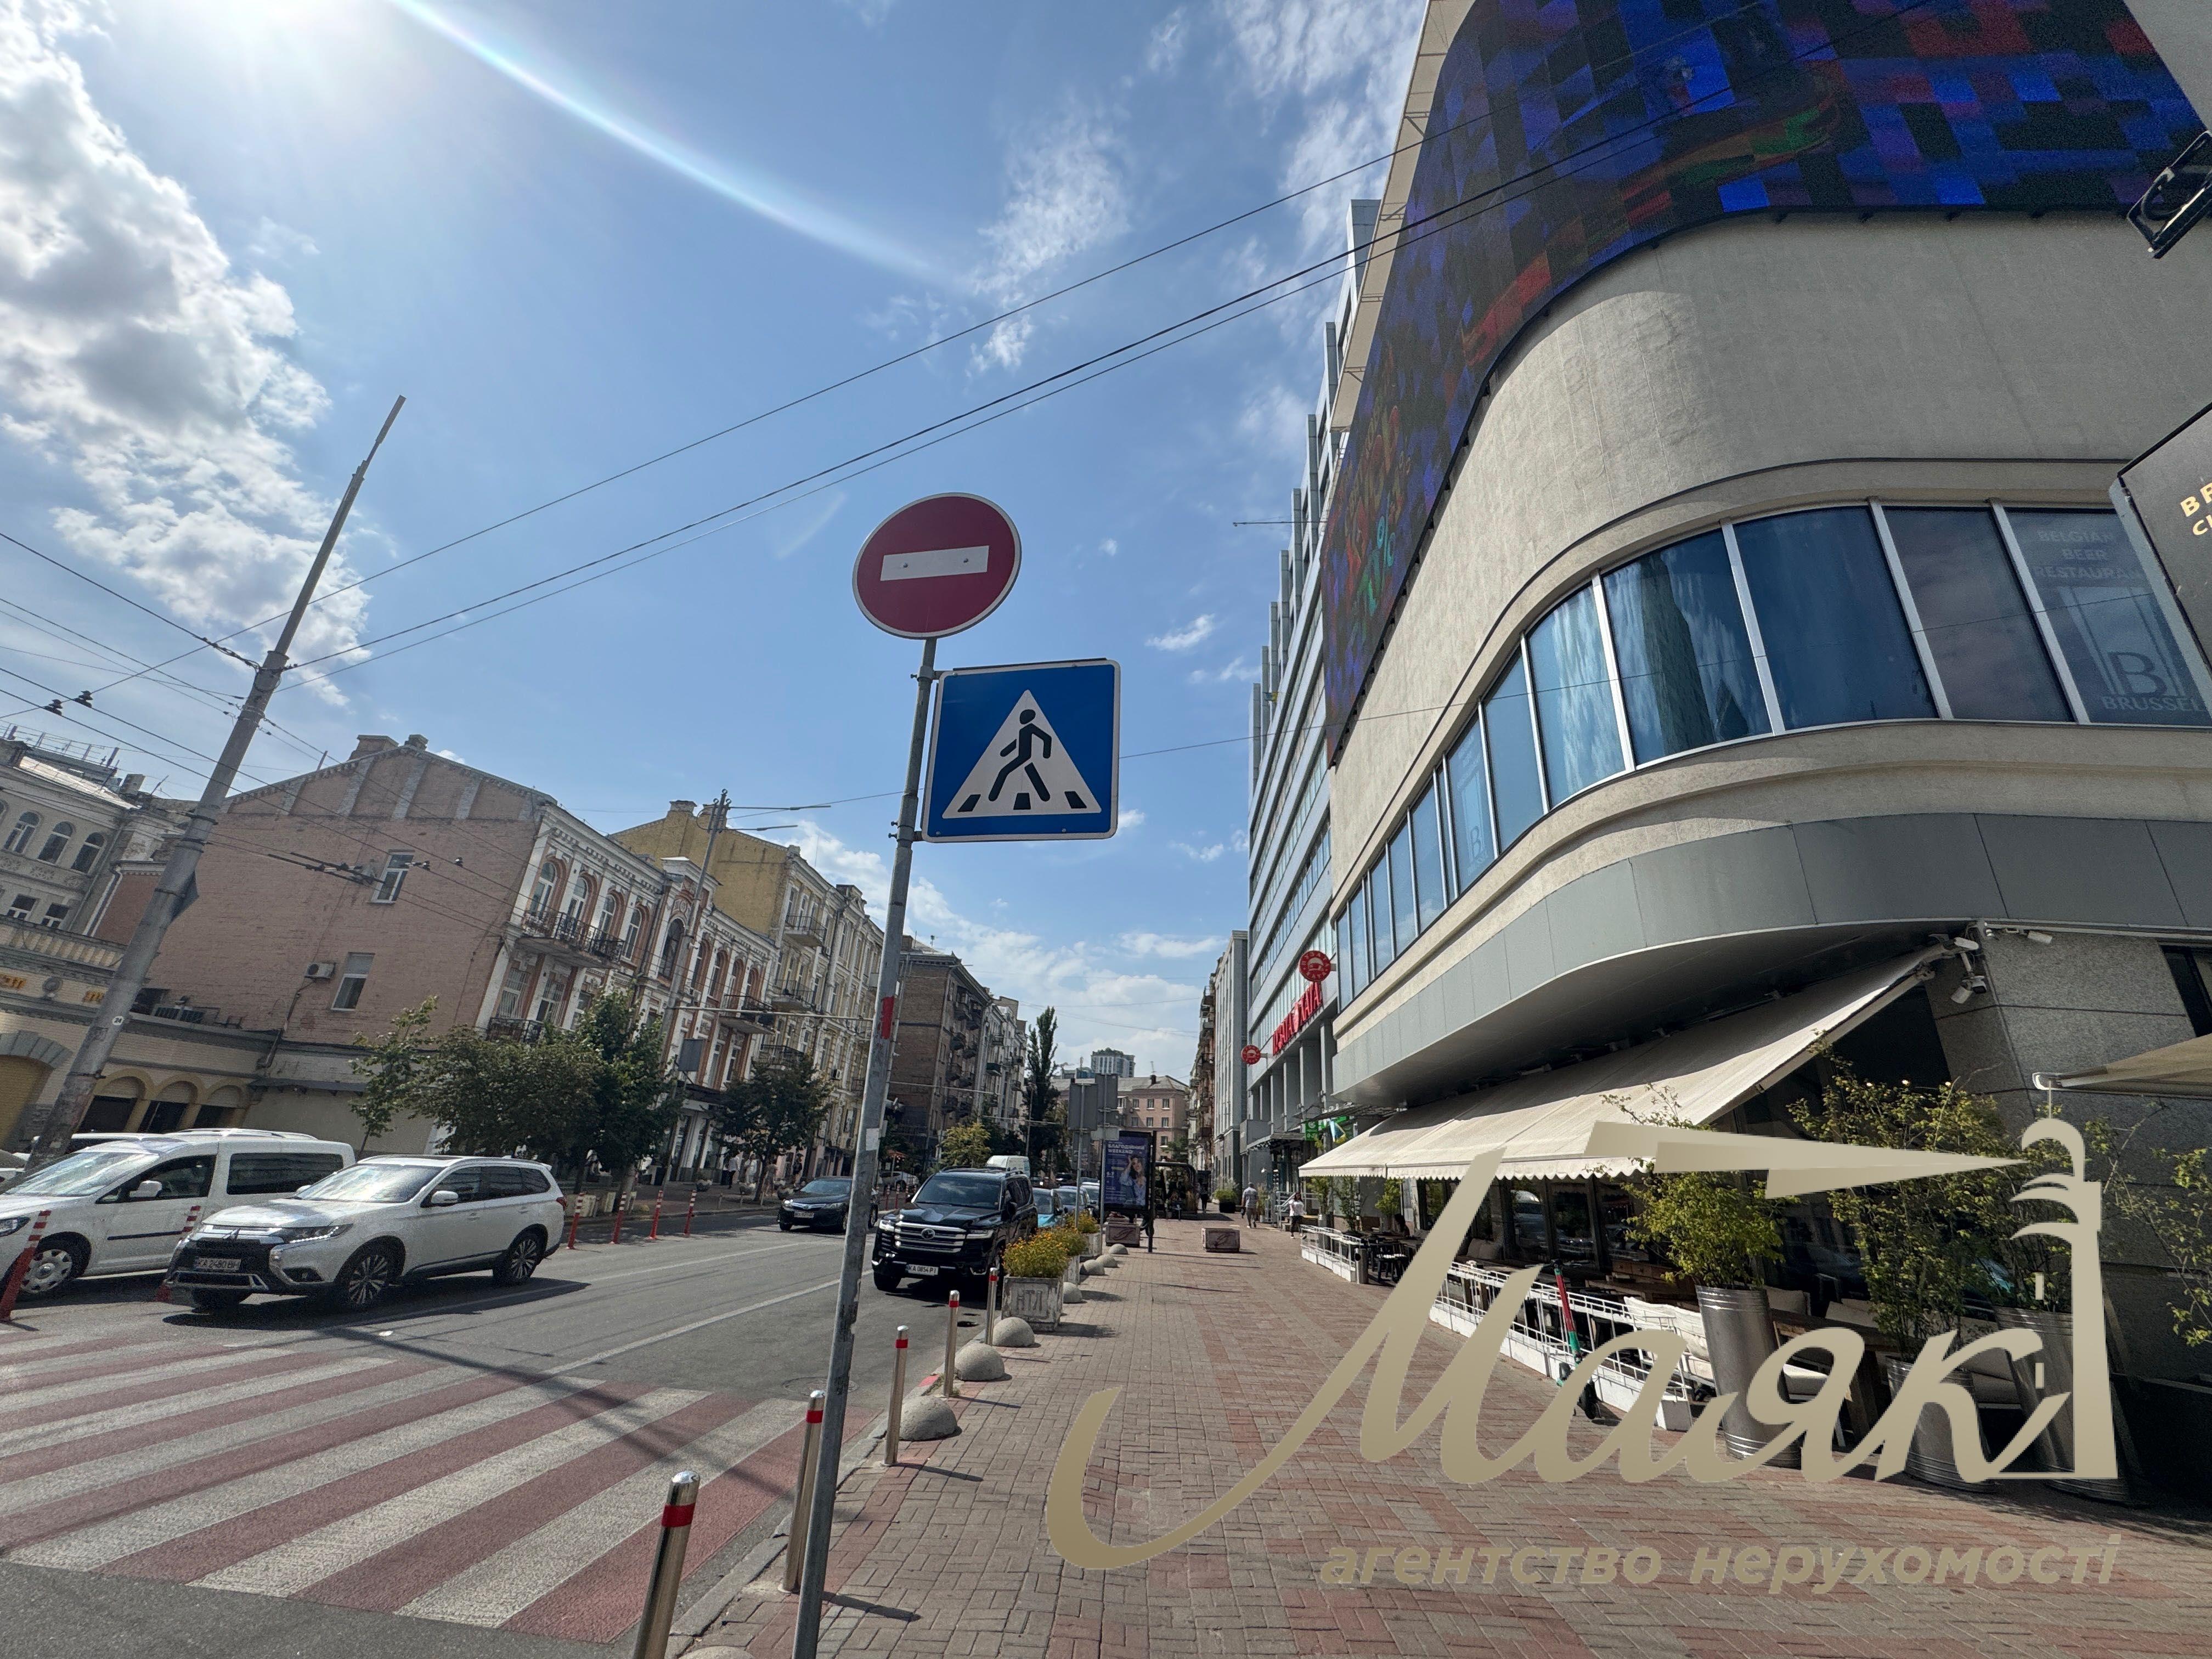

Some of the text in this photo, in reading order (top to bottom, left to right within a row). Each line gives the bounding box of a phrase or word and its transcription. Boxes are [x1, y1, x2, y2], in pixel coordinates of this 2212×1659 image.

[2037, 530, 2116, 542] BELGIAN
[2062, 548, 2109, 561] BEER
[2108, 651, 2167, 697] B
